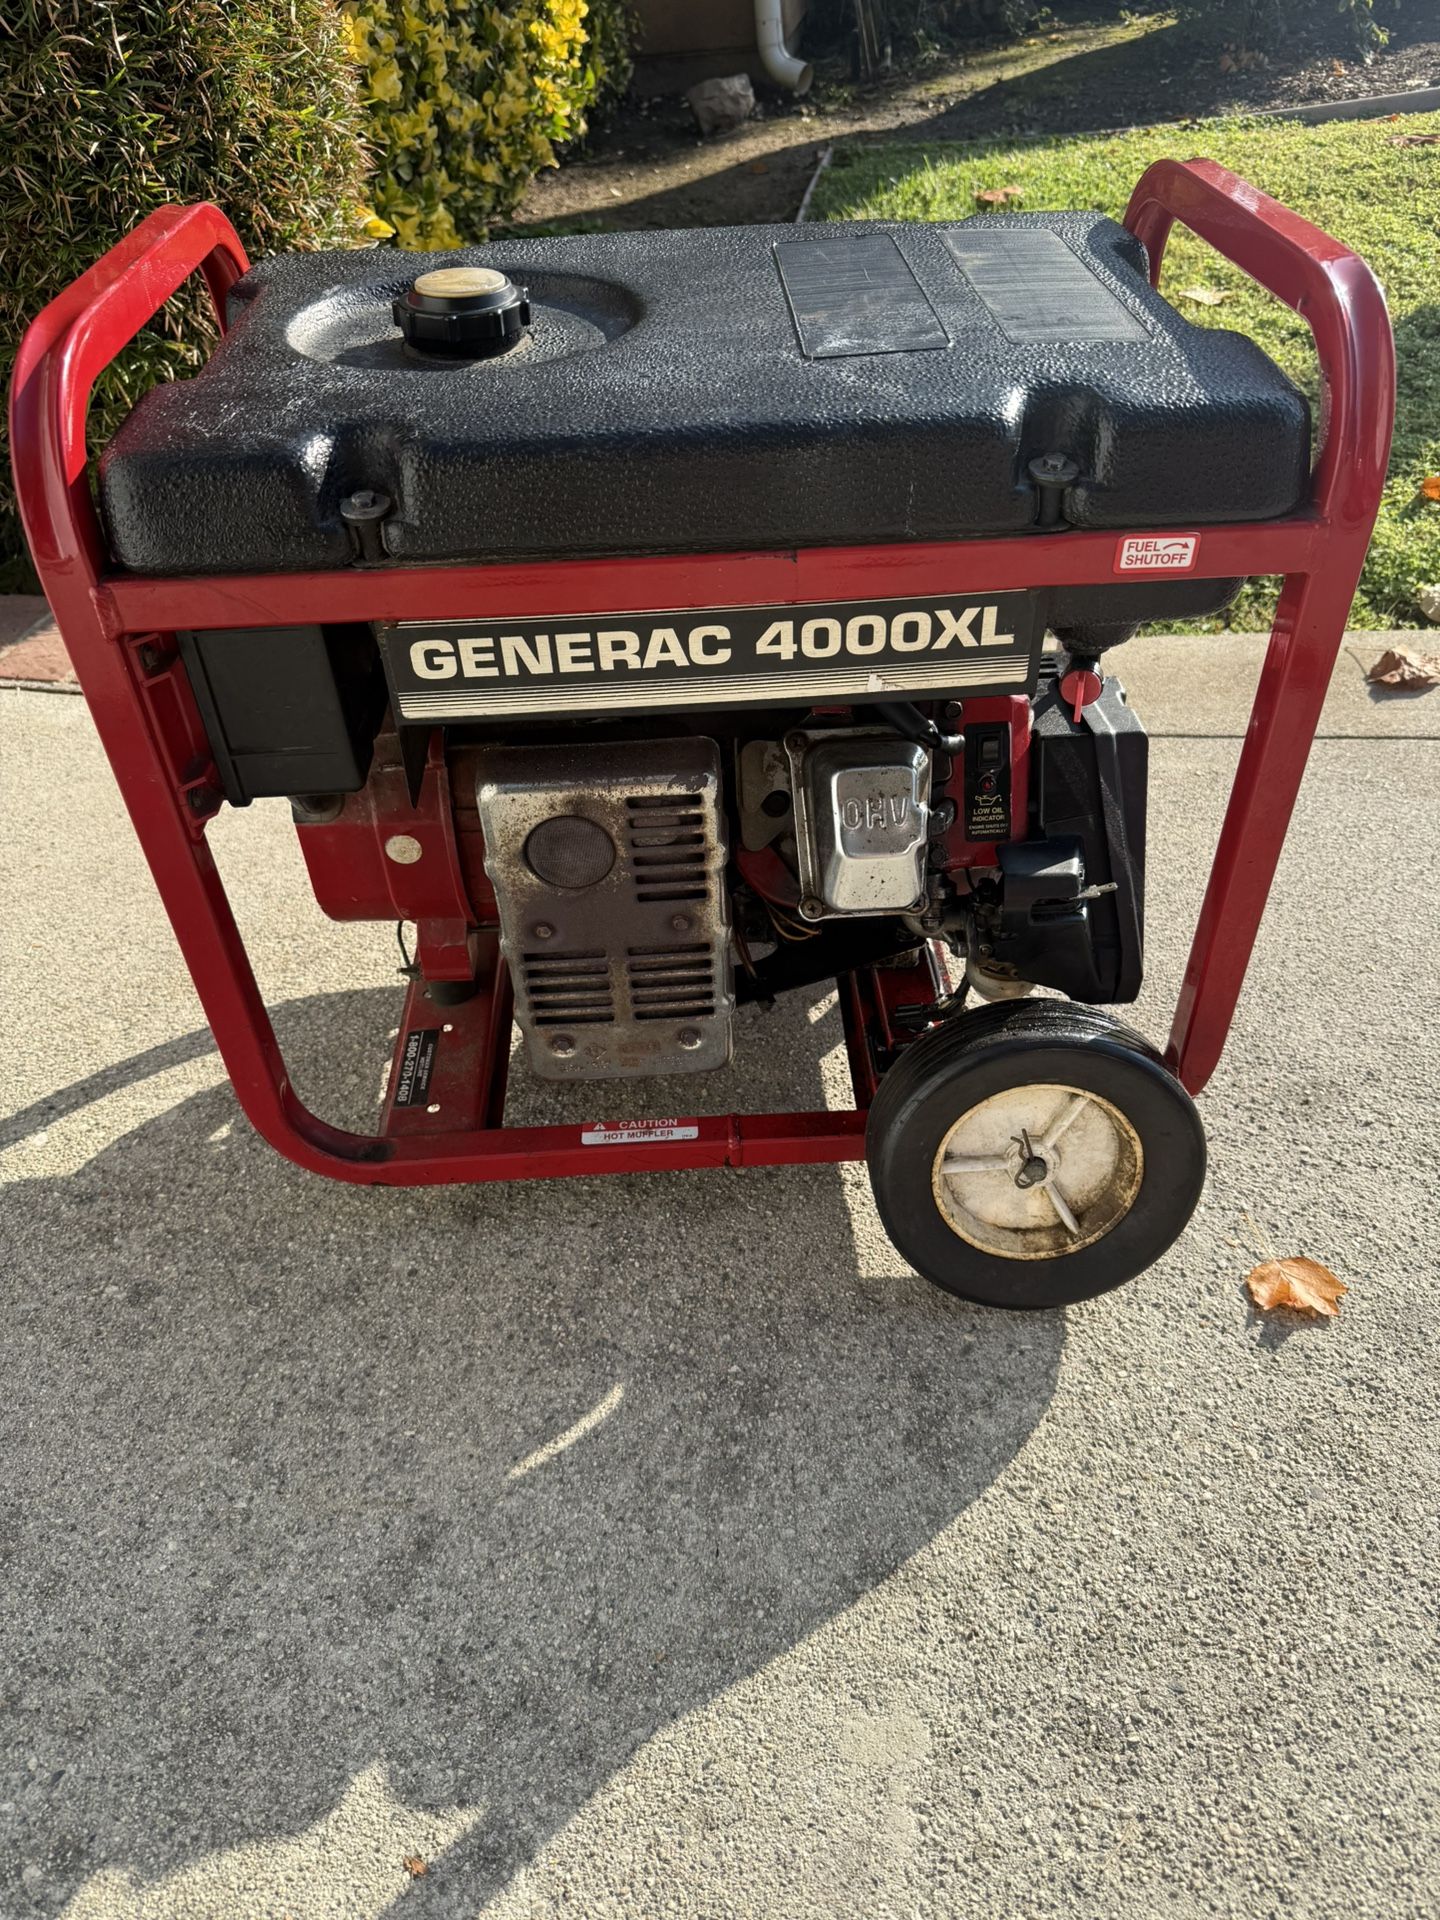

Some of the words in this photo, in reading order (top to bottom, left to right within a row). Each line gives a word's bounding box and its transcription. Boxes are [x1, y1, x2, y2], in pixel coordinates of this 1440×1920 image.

[1127, 541, 1160, 552] FUEL
[1125, 553, 1188, 565] SHUTOFF
[409, 624, 732, 680] GENERAC
[755, 606, 1014, 661] 4000XL
[842, 796, 910, 830] OHV
[973, 807, 991, 815] LOW
[992, 806, 1005, 814] OIL
[972, 814, 1005, 822] INDICATOR
[424, 1043, 433, 1069] CUSTOMER
[397, 1035, 419, 1102] 1-800-270-1408
[420, 1069, 429, 1090] SERVICE
[618, 1118, 677, 1129] CAUTION
[604, 1132, 624, 1140] HOT
[627, 1129, 673, 1139] MUFFLER
